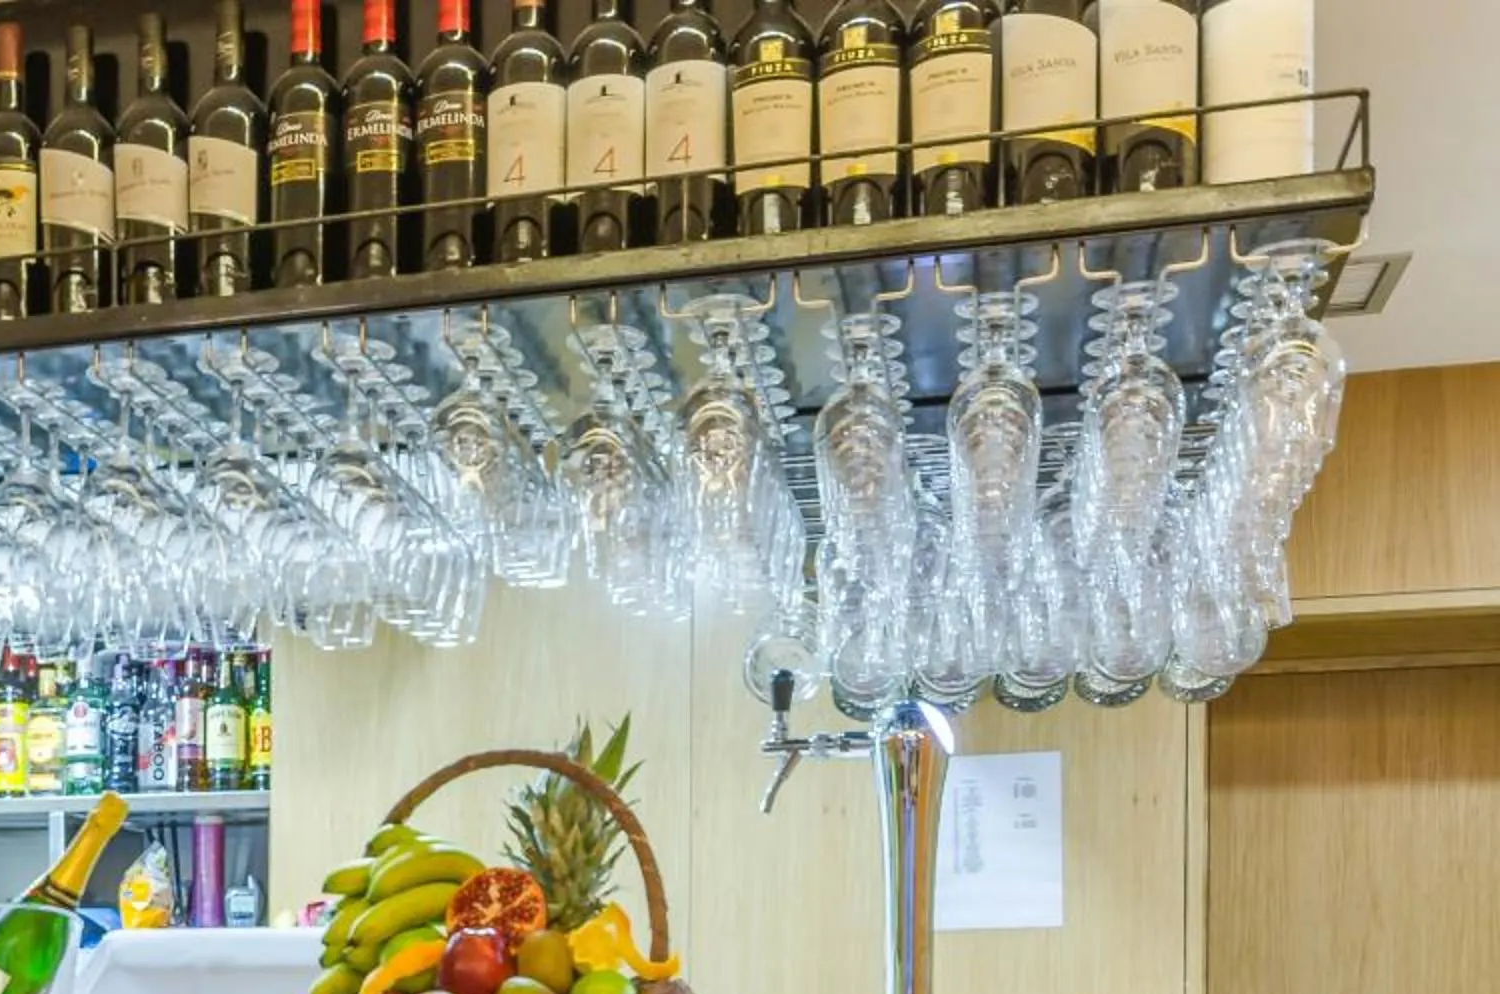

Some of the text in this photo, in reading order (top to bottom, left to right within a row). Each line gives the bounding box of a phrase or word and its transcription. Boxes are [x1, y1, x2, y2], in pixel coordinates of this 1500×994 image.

[417, 111, 485, 134] ERMELINDA
[593, 145, 619, 178] 4
[667, 132, 692, 167] 4
[503, 153, 526, 188] 4
[153, 719, 165, 781] TABOO
